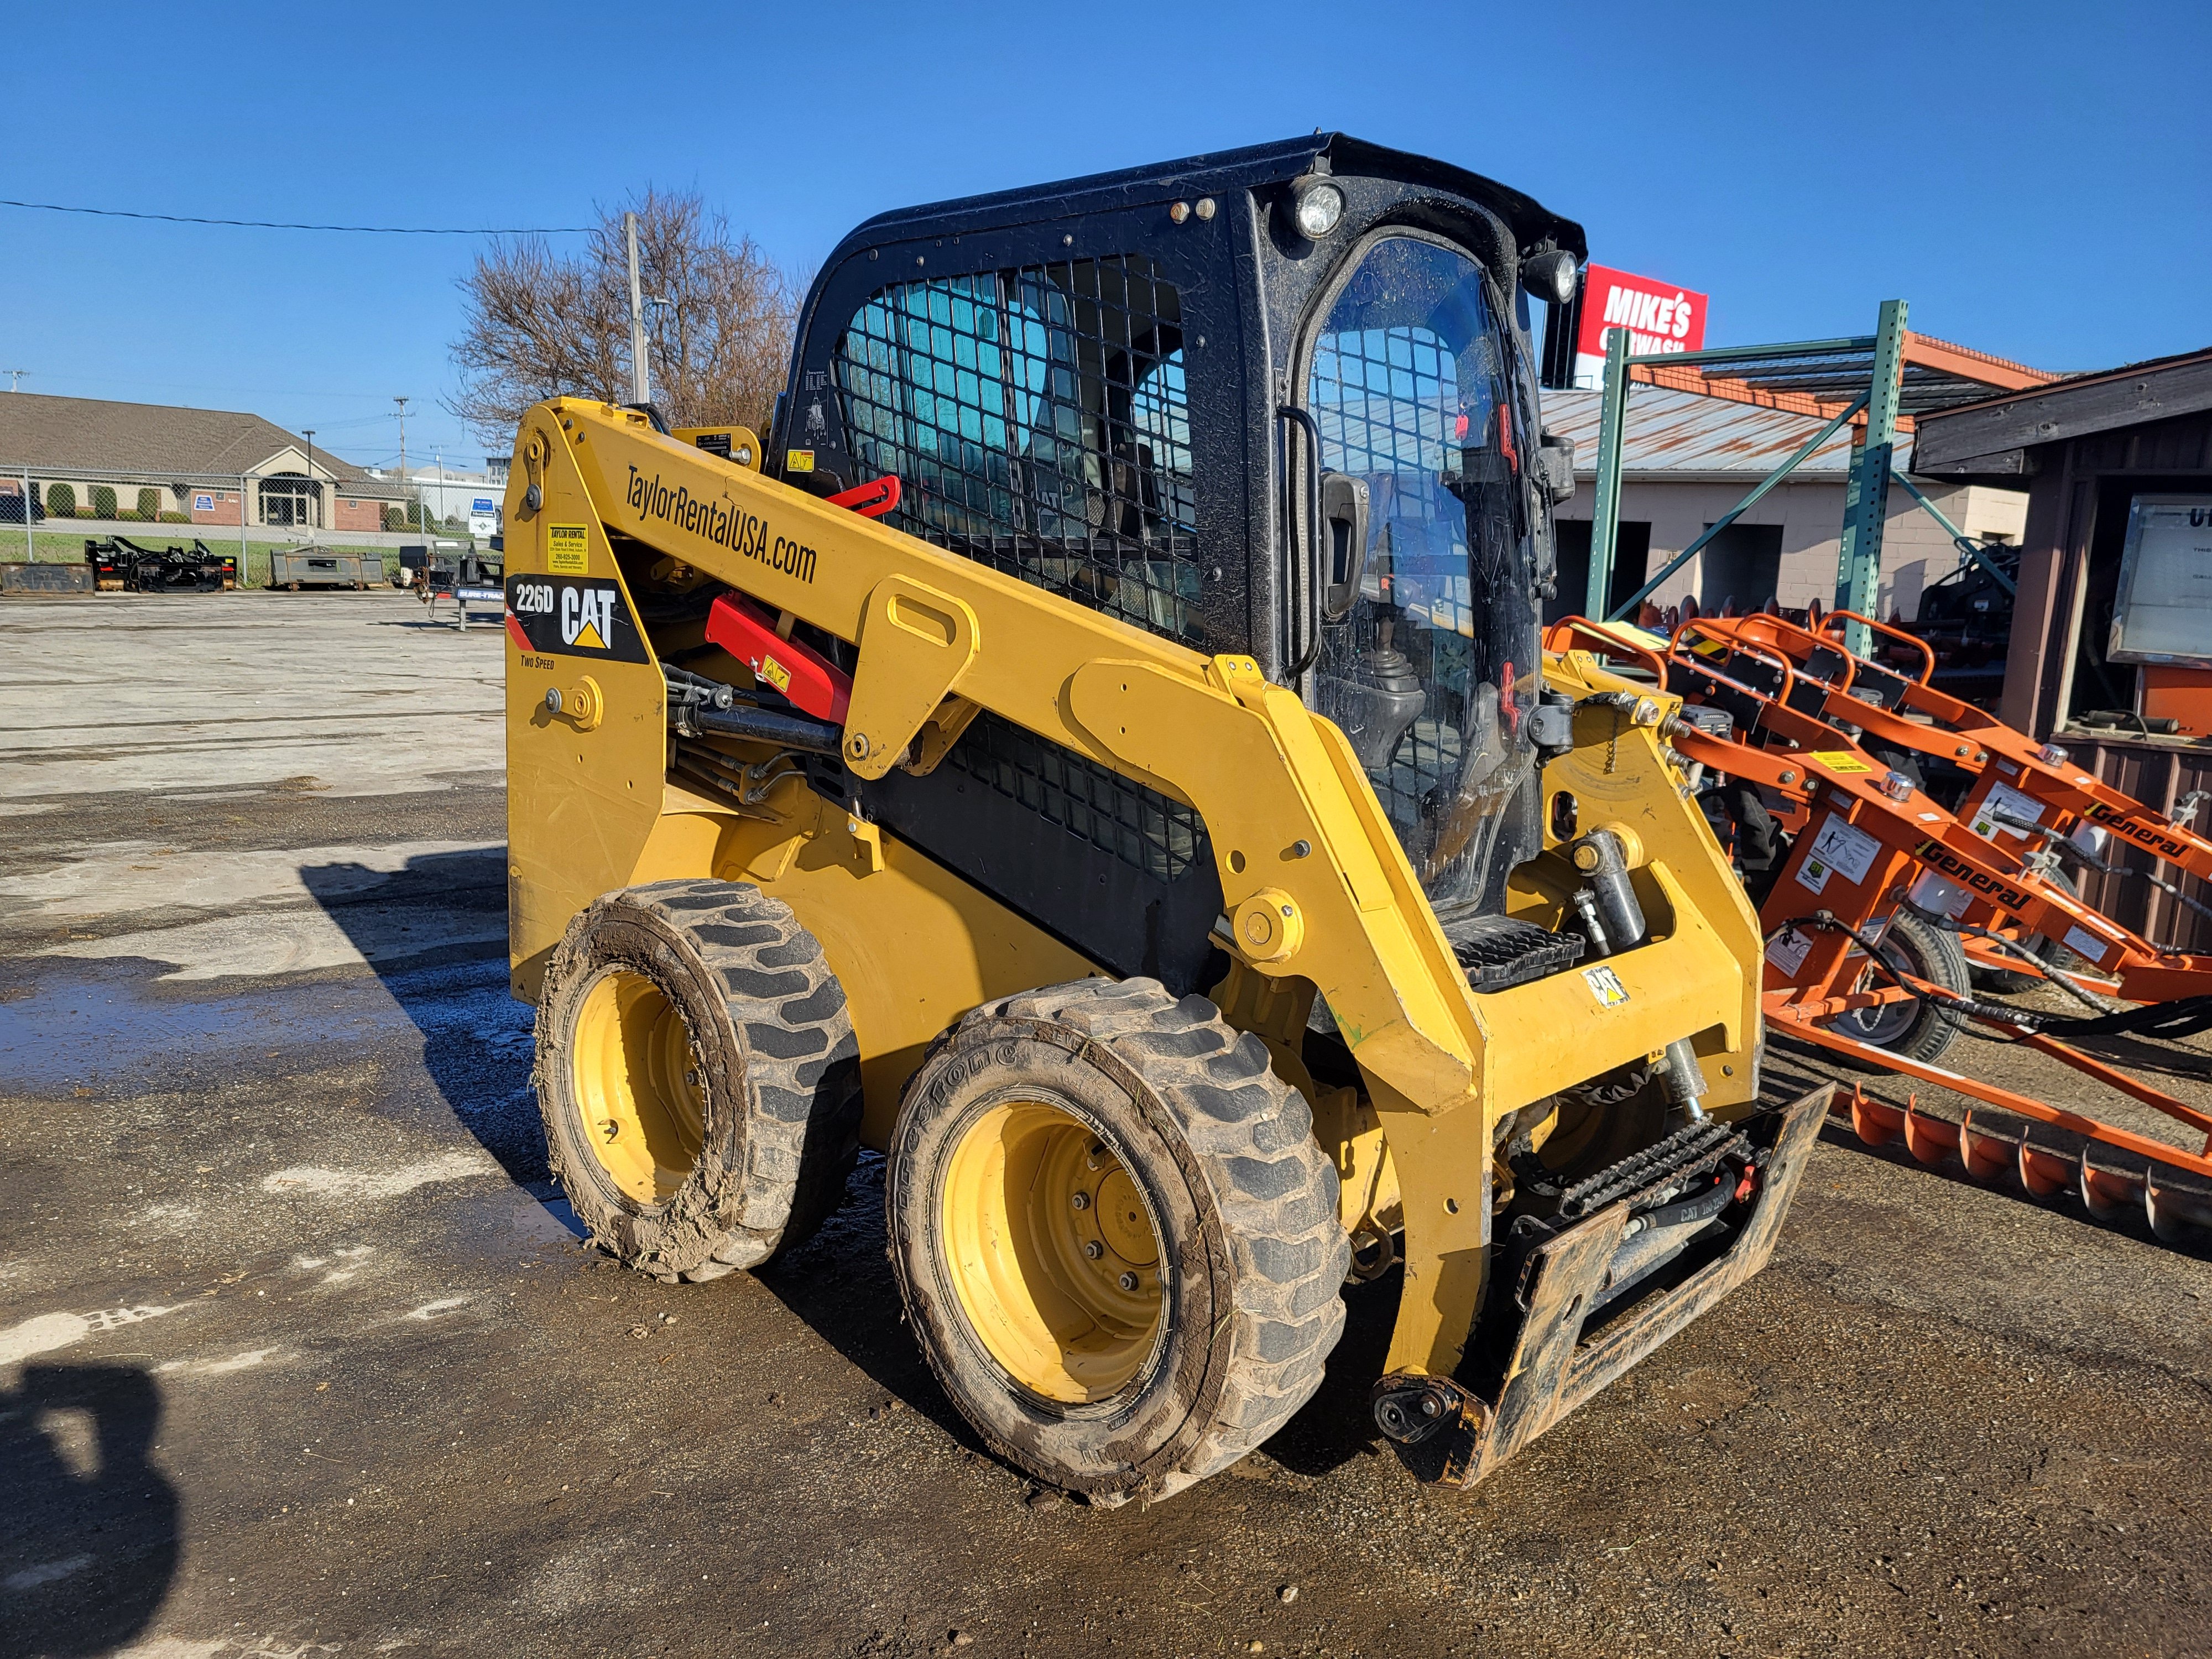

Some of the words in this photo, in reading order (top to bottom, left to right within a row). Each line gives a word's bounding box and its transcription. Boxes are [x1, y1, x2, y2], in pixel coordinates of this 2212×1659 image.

[1604, 285, 1692, 338] MIKE'S
[550, 527, 567, 539] TAYLOR
[568, 530, 586, 539] RENTAL
[627, 465, 817, 585] TaylorRentalUSA.com
[517, 583, 554, 613] 226D
[562, 587, 615, 649] CAT
[2091, 804, 2190, 858] General
[1810, 862, 1824, 874] 811
[1922, 842, 2032, 911] General
[1585, 969, 1625, 1006] CAT
[1681, 1206, 1697, 1222] CAT
